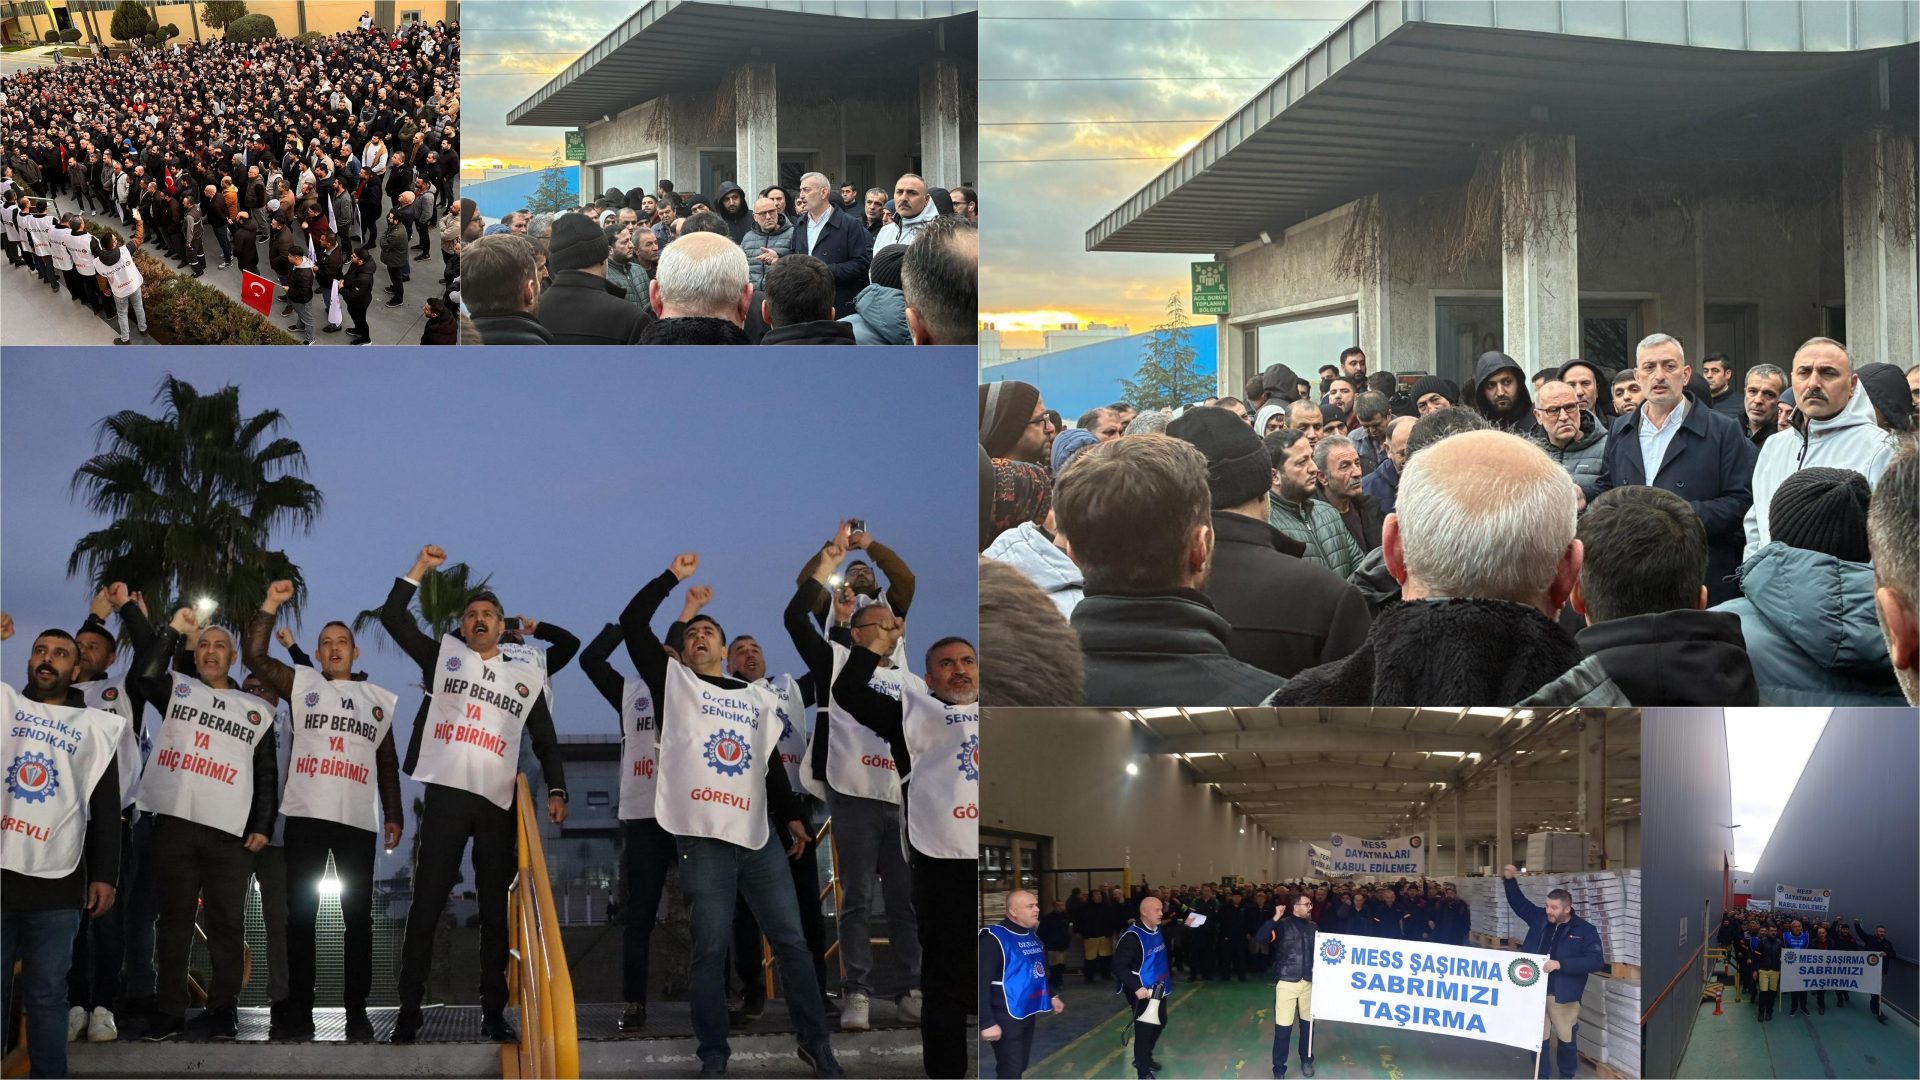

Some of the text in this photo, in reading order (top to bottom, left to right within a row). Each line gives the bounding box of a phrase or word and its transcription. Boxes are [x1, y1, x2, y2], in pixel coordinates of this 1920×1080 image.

[482, 665, 496, 682] YA
[212, 696, 226, 710] YA
[341, 697, 354, 710] YA
[443, 678, 523, 719] HEP BERABER
[465, 703, 481, 721] YA
[701, 704, 759, 731] SENDİKASI
[15, 709, 82, 743] ÖZÇELİK-İŞ
[171, 704, 198, 721] HEP
[199, 710, 255, 745] BERABER
[304, 714, 377, 743] HEP BERABER
[11, 727, 77, 756] SENDİKASI
[194, 730, 210, 750] YA
[329, 736, 344, 752] YA
[433, 720, 507, 757] HİÇ BİRİMİZ
[157, 747, 238, 785] HİÇ BİRİMİZ
[296, 754, 369, 784] HİÇ BİRİMİZ
[633, 759, 654, 779] HİÇ
[690, 787, 751, 811] GÖREVLİ
[1345, 848, 1410, 860] DAYATMALARI
[1361, 840, 1387, 849] MESS
[1334, 861, 1367, 873] KABUL
[1369, 862, 1417, 873] EDİLEMEZ
[1778, 901, 1798, 909] KABUL
[1351, 947, 1503, 982] MESS ŞAŞIRMA
[1798, 954, 1865, 966] MESS ŞAŞIRMA
[1798, 966, 1864, 976] SABRIMIZI
[1350, 971, 1499, 1007] SABRIMIZI
[1802, 978, 1859, 989] TAŞIRMA
[1359, 1000, 1487, 1034] TAŞIRMA
